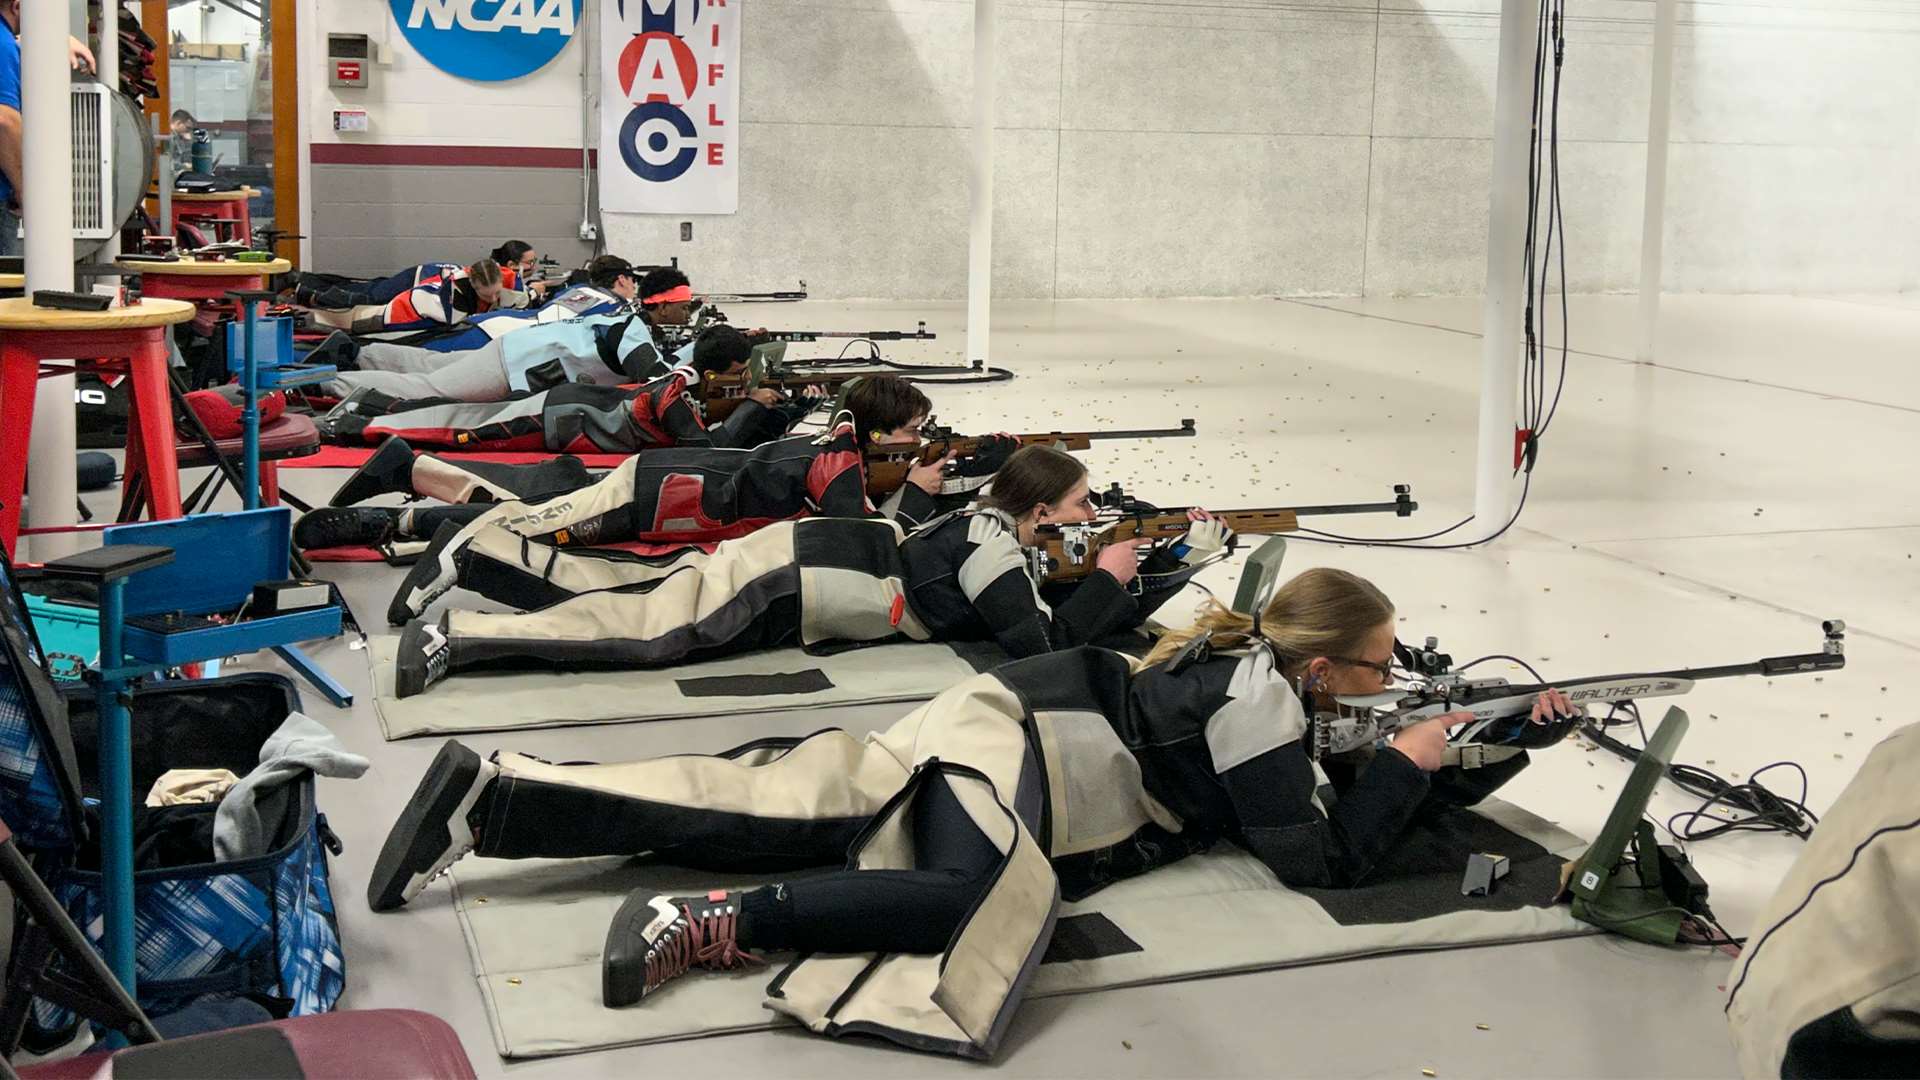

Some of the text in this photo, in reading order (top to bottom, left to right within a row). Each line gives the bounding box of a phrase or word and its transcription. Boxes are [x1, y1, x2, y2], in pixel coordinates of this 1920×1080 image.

[407, 0, 575, 36] NCAA
[707, 0, 726, 166] IFLE
[1570, 684, 1651, 701] WALTHER
